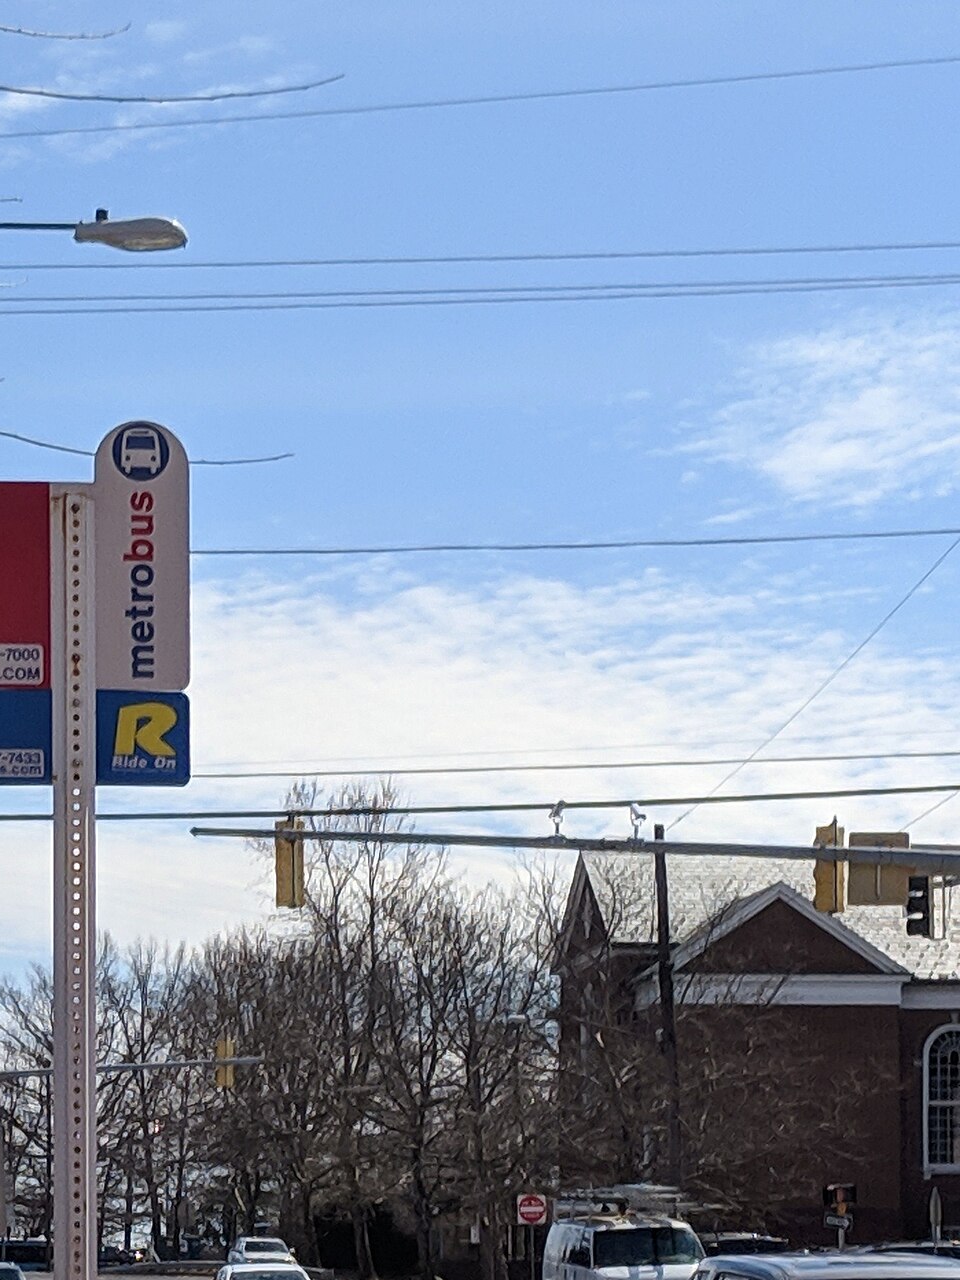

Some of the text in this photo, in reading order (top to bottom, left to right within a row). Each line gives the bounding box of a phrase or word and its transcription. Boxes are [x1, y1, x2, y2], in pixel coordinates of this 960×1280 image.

[122, 491, 155, 679] metrobus
[112, 755, 177, 769] Ride On
